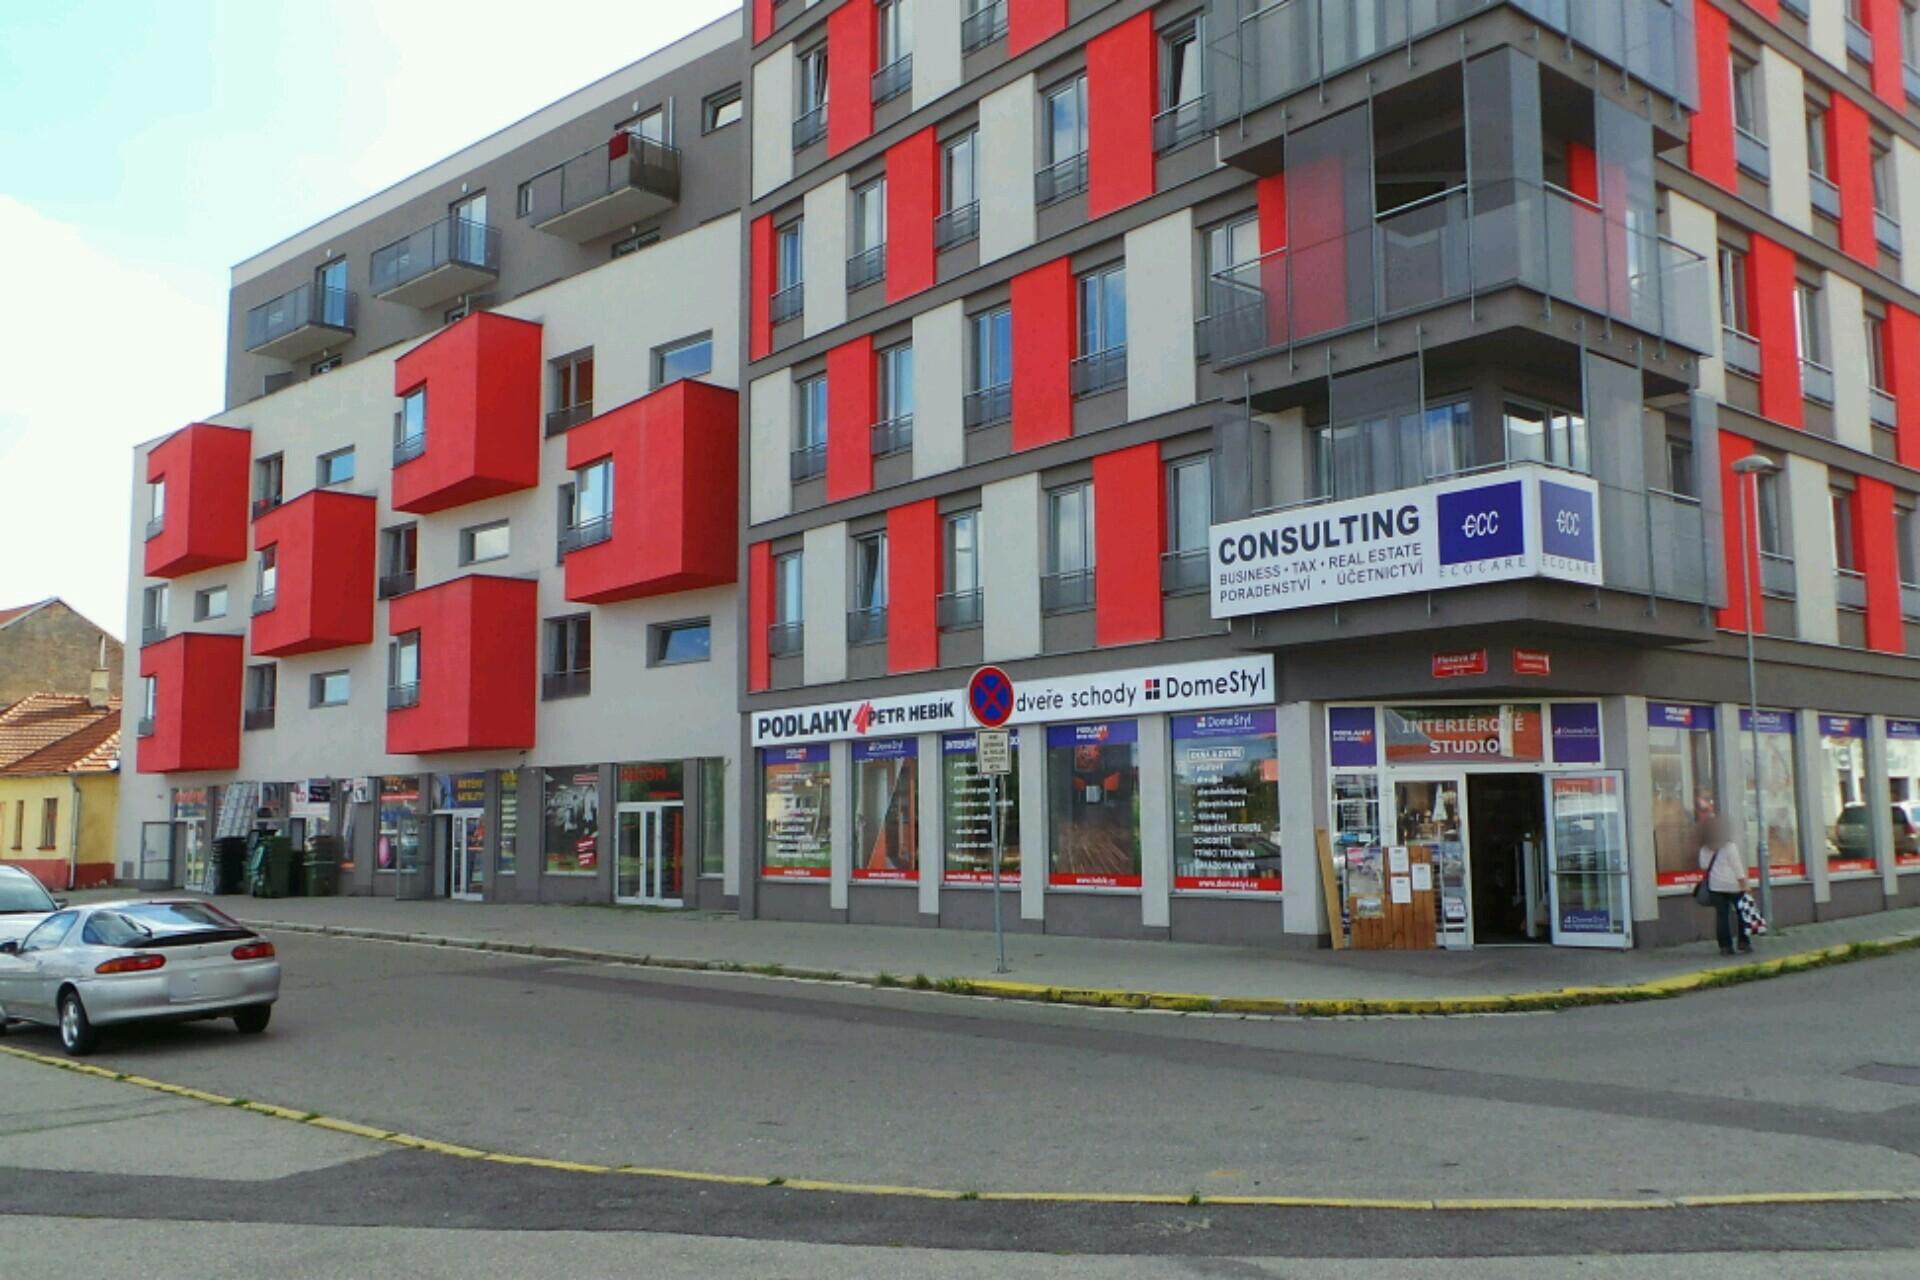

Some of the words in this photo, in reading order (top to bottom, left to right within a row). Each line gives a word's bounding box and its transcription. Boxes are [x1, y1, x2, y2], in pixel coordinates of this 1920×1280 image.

[1218, 504, 1421, 565] CONSULTING
[1219, 564, 1281, 586] BUSINESS
[1292, 558, 1318, 575] TAX
[1328, 551, 1365, 570] REAL
[1368, 543, 1422, 563] ESTATE
[1219, 575, 1312, 603] PORADENSTVÍ
[1336, 557, 1424, 586] ÚČETNICTVÍ
[1440, 556, 1528, 578] ECOCARE
[1541, 554, 1597, 576] ECOCARE
[1016, 688, 1064, 712] dveře
[1071, 682, 1137, 708] schody
[1166, 667, 1266, 699] DomeStyl
[758, 708, 852, 739] PODLAHY
[868, 707, 905, 727] PETR
[909, 697, 954, 722] HEBÍK
[1208, 713, 1252, 729] DomeStyl
[1402, 713, 1525, 734] INTERIÉROÉ
[1429, 739, 1499, 754] STUDIO
